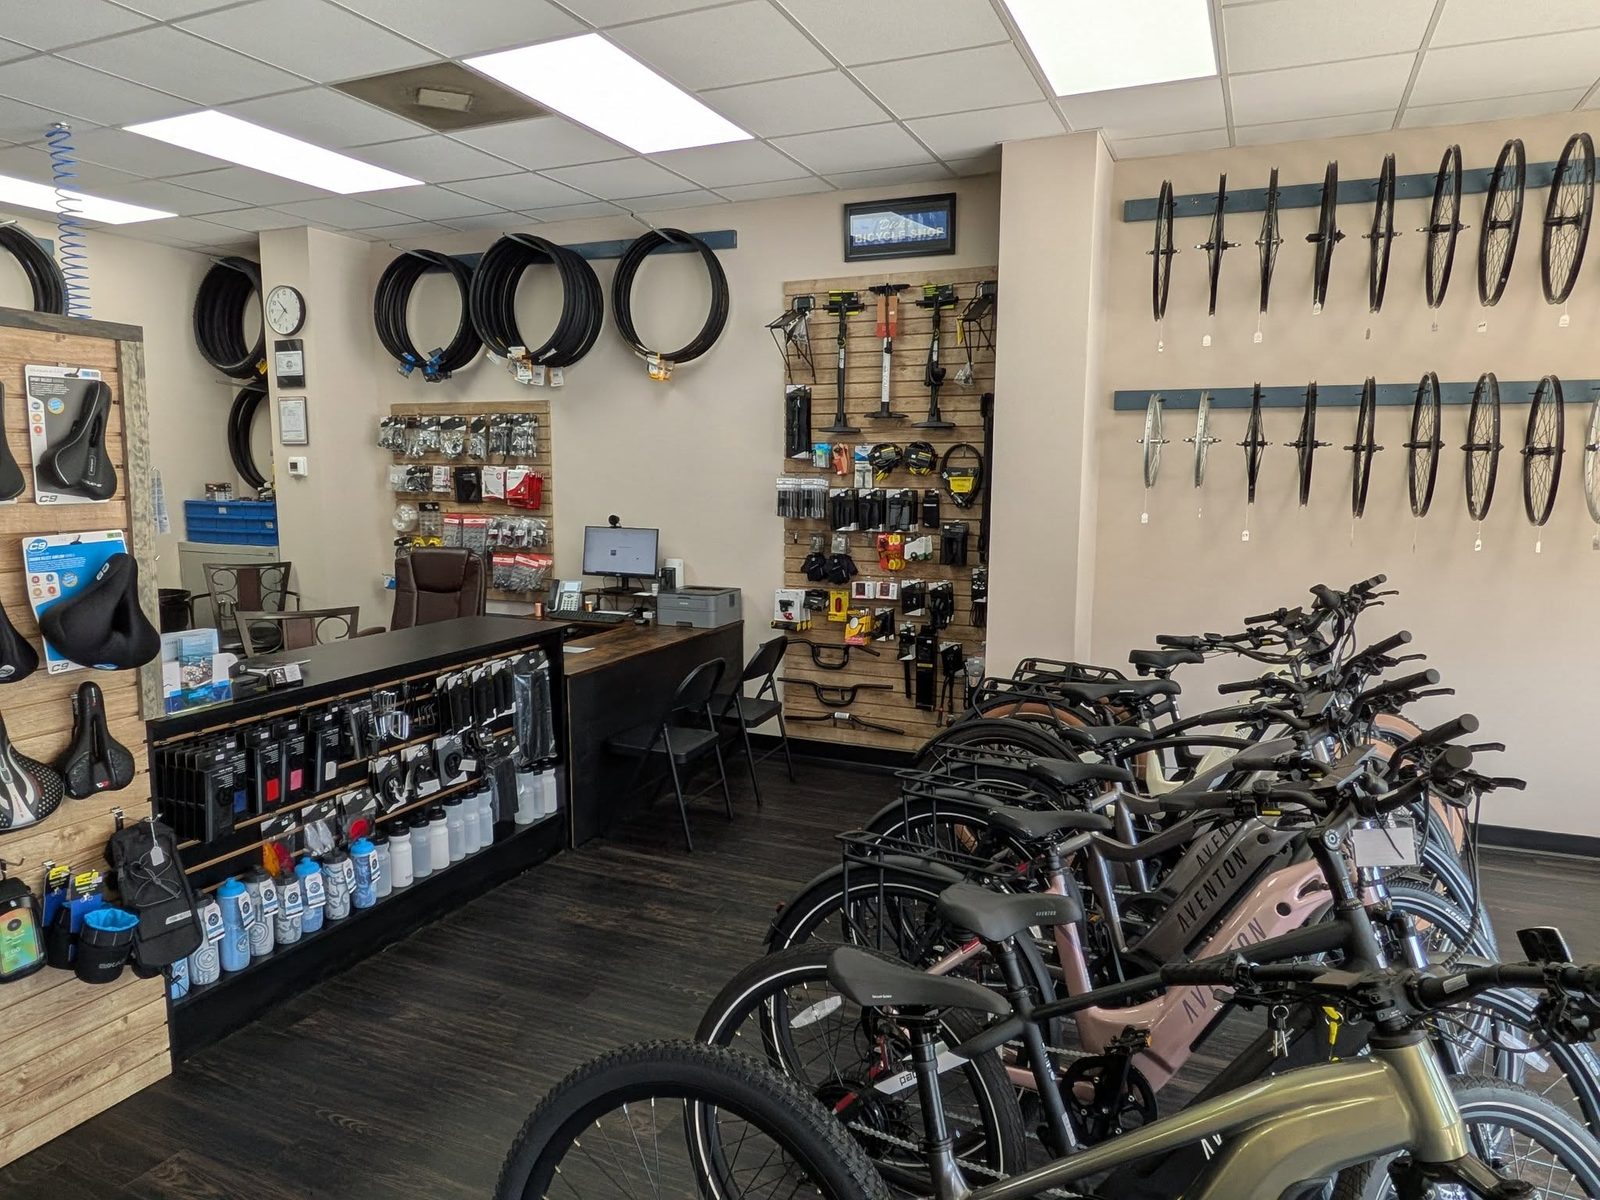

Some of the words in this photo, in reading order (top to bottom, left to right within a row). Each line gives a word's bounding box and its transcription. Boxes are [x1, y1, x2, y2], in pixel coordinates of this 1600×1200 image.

[854, 231, 906, 243] BICYCLE
[911, 227, 945, 239] SHOP
[40, 495, 58, 503] C9
[29, 541, 48, 551] C9
[51, 662, 70, 673] C9
[1176, 847, 1248, 934] AVENTON
[1445, 907, 1471, 930] KENDA
